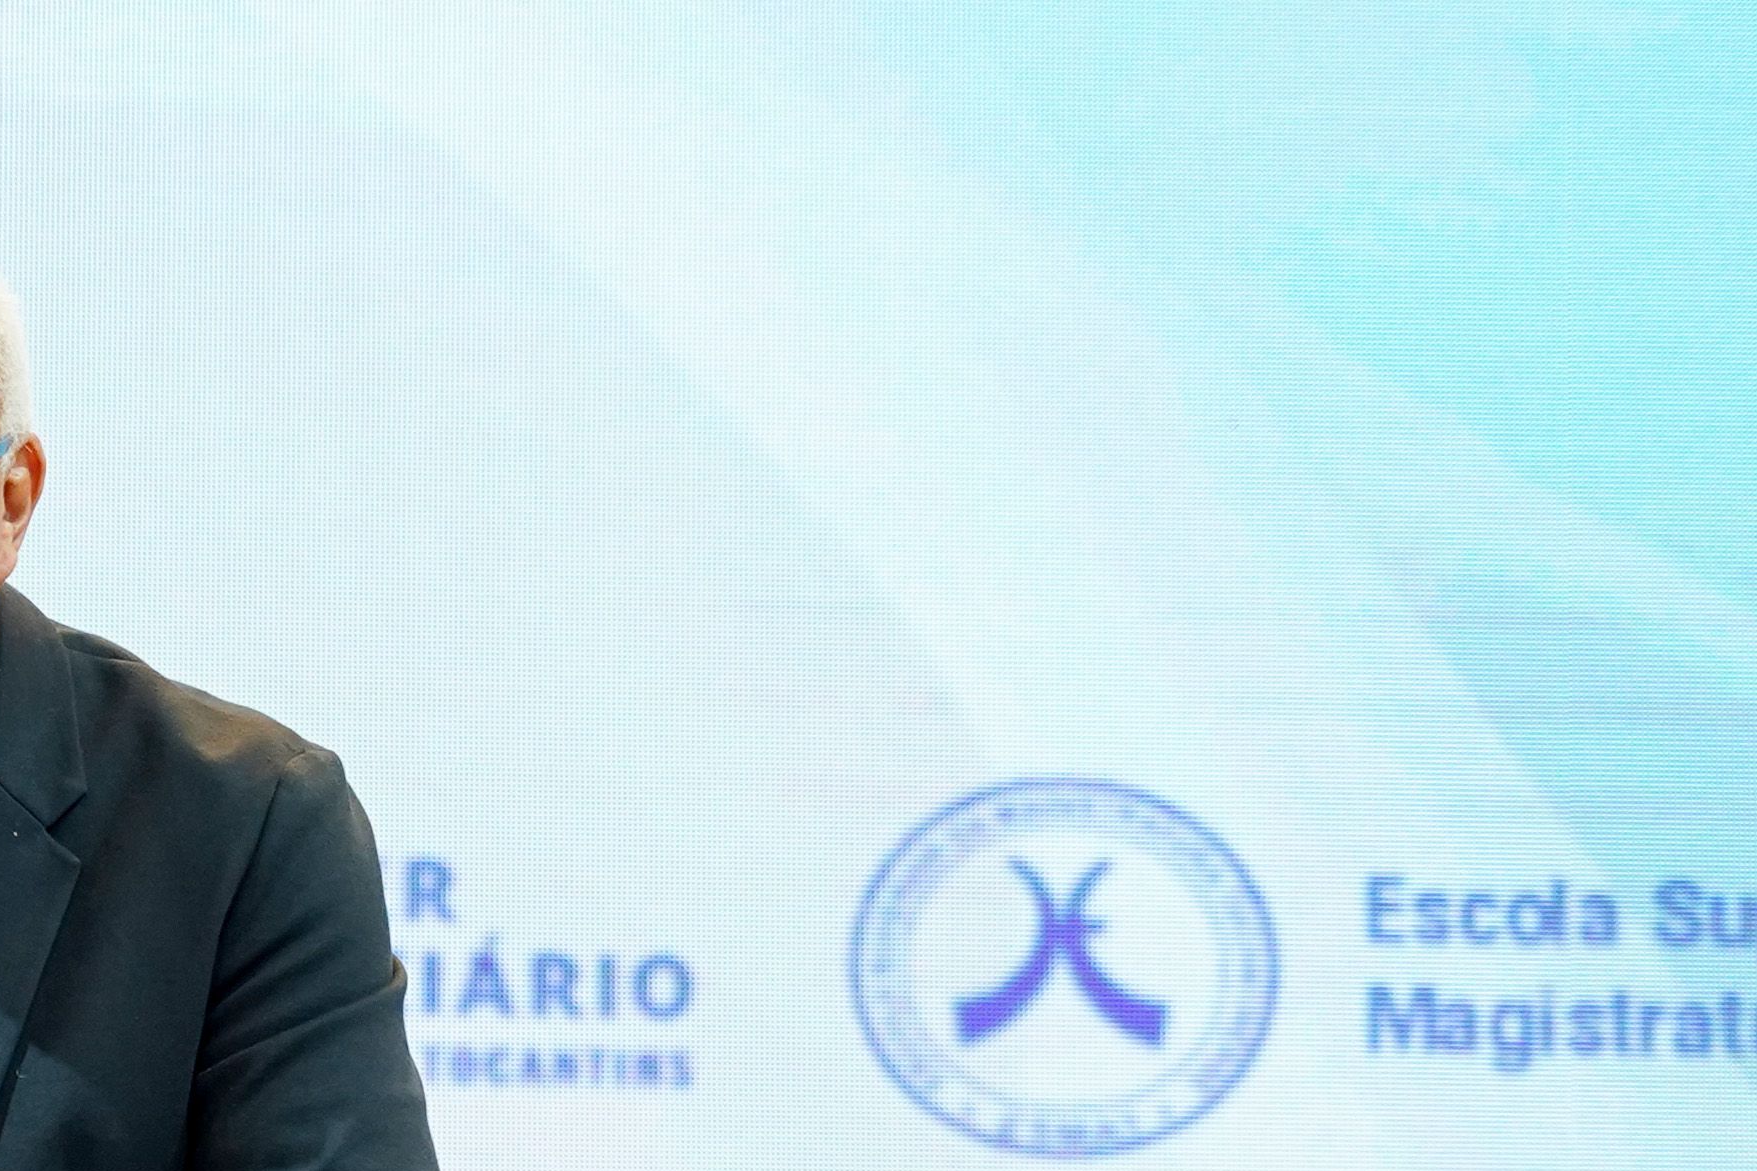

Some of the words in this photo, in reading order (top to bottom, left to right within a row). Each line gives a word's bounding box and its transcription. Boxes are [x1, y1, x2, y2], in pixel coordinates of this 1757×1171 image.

[1366, 871, 1618, 948] Escola
[394, 933, 696, 1022] IÁRIO
[1366, 982, 1757, 1076] Magistrat
